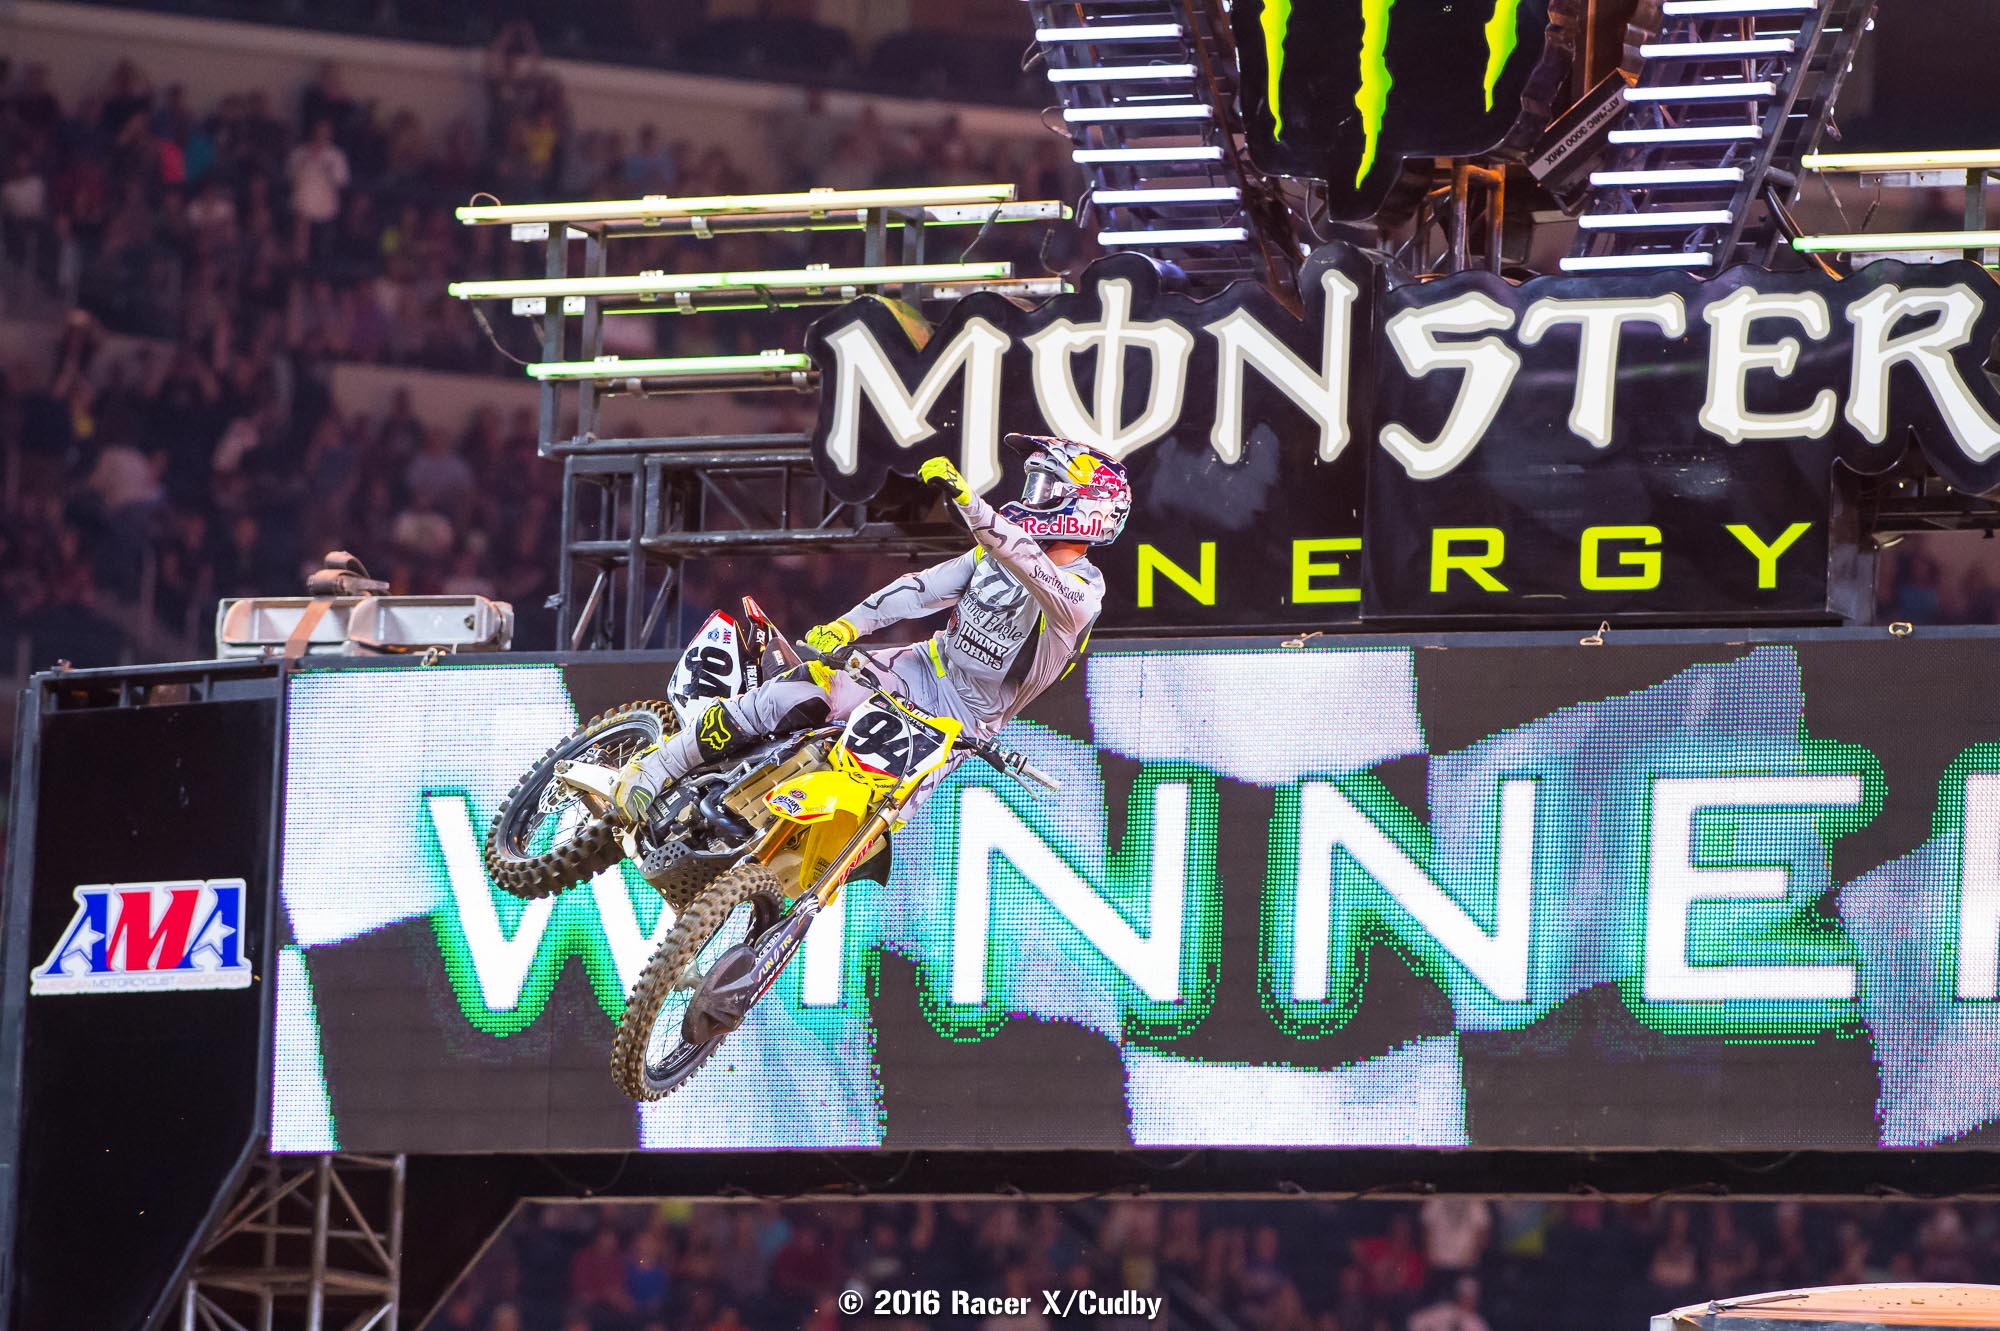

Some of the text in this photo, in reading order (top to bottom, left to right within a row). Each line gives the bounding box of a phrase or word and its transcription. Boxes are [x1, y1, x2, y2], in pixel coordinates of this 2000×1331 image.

[1544, 143, 1567, 165] DMX
[1567, 126, 1588, 147] 3000
[1023, 513, 1103, 537] Red Bull
[1137, 521, 1811, 607] NERGY
[960, 622, 1008, 658] JIMMY
[981, 612, 1026, 641] Eagle
[955, 635, 1003, 669] JOHN'S
[683, 646, 733, 701] 94
[845, 711, 940, 778] 94
[40, 885, 245, 977] AMA
